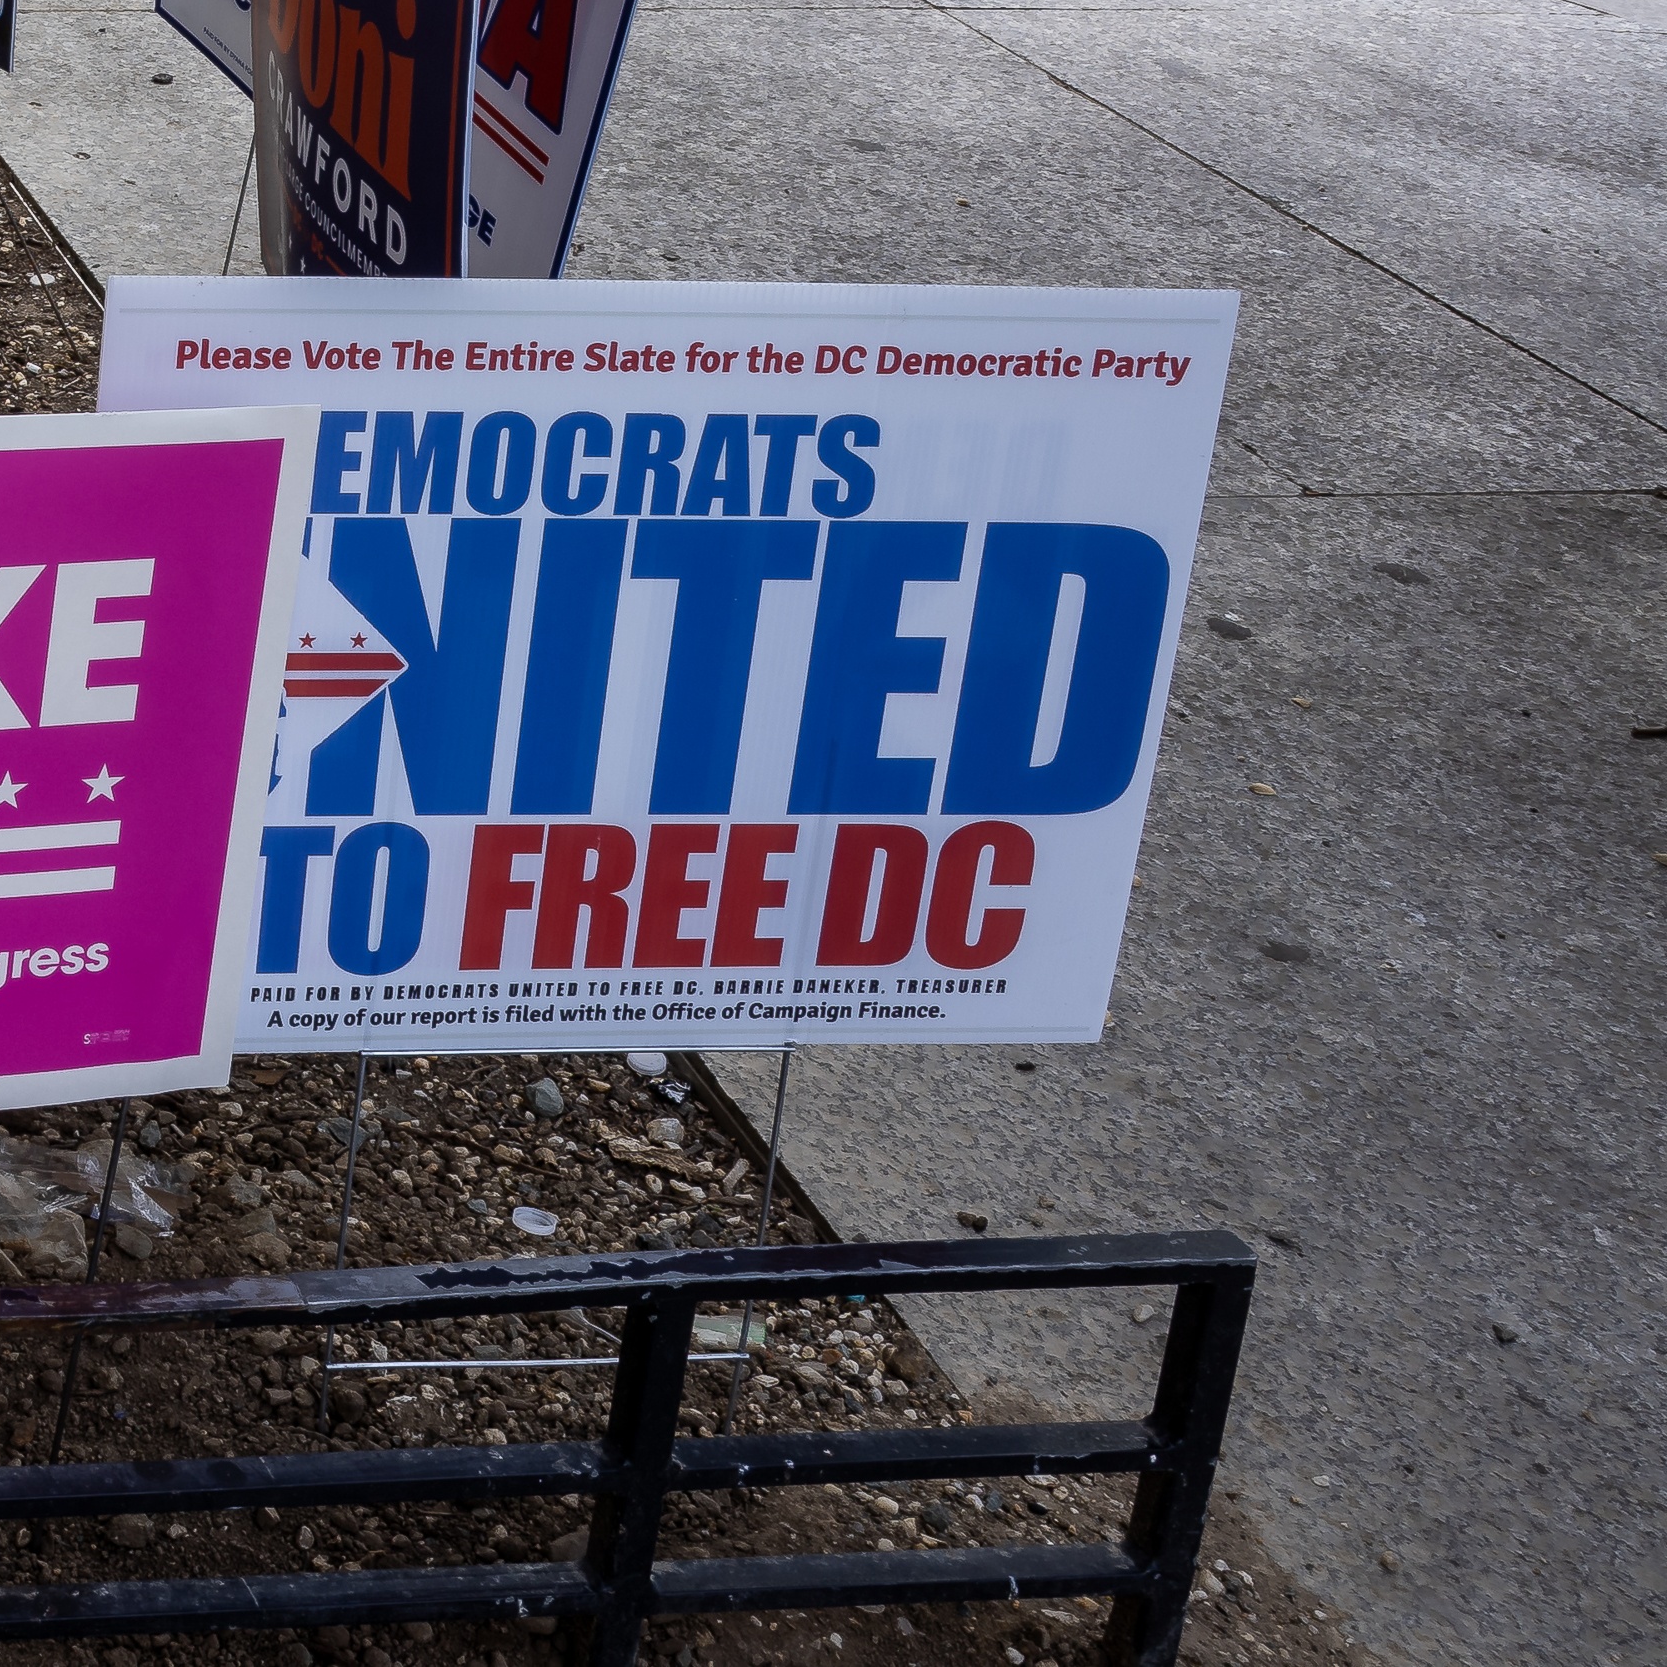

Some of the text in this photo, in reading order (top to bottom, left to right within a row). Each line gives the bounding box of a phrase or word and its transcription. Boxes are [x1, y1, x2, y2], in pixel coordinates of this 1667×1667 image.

[267, 49, 408, 267] CRAWFORD
[175, 339, 1193, 387] Please Vote The Entire Slate for the DC Democratic Party
[255, 818, 1036, 977] TO FREE DC
[249, 977, 1009, 1003] PAID FOR BY DEMOCRATS UNITED TO FREE BARRIE TREASURER
[266, 999, 947, 1032] A copy of our report is filed with the Office of Campaign Finance.
